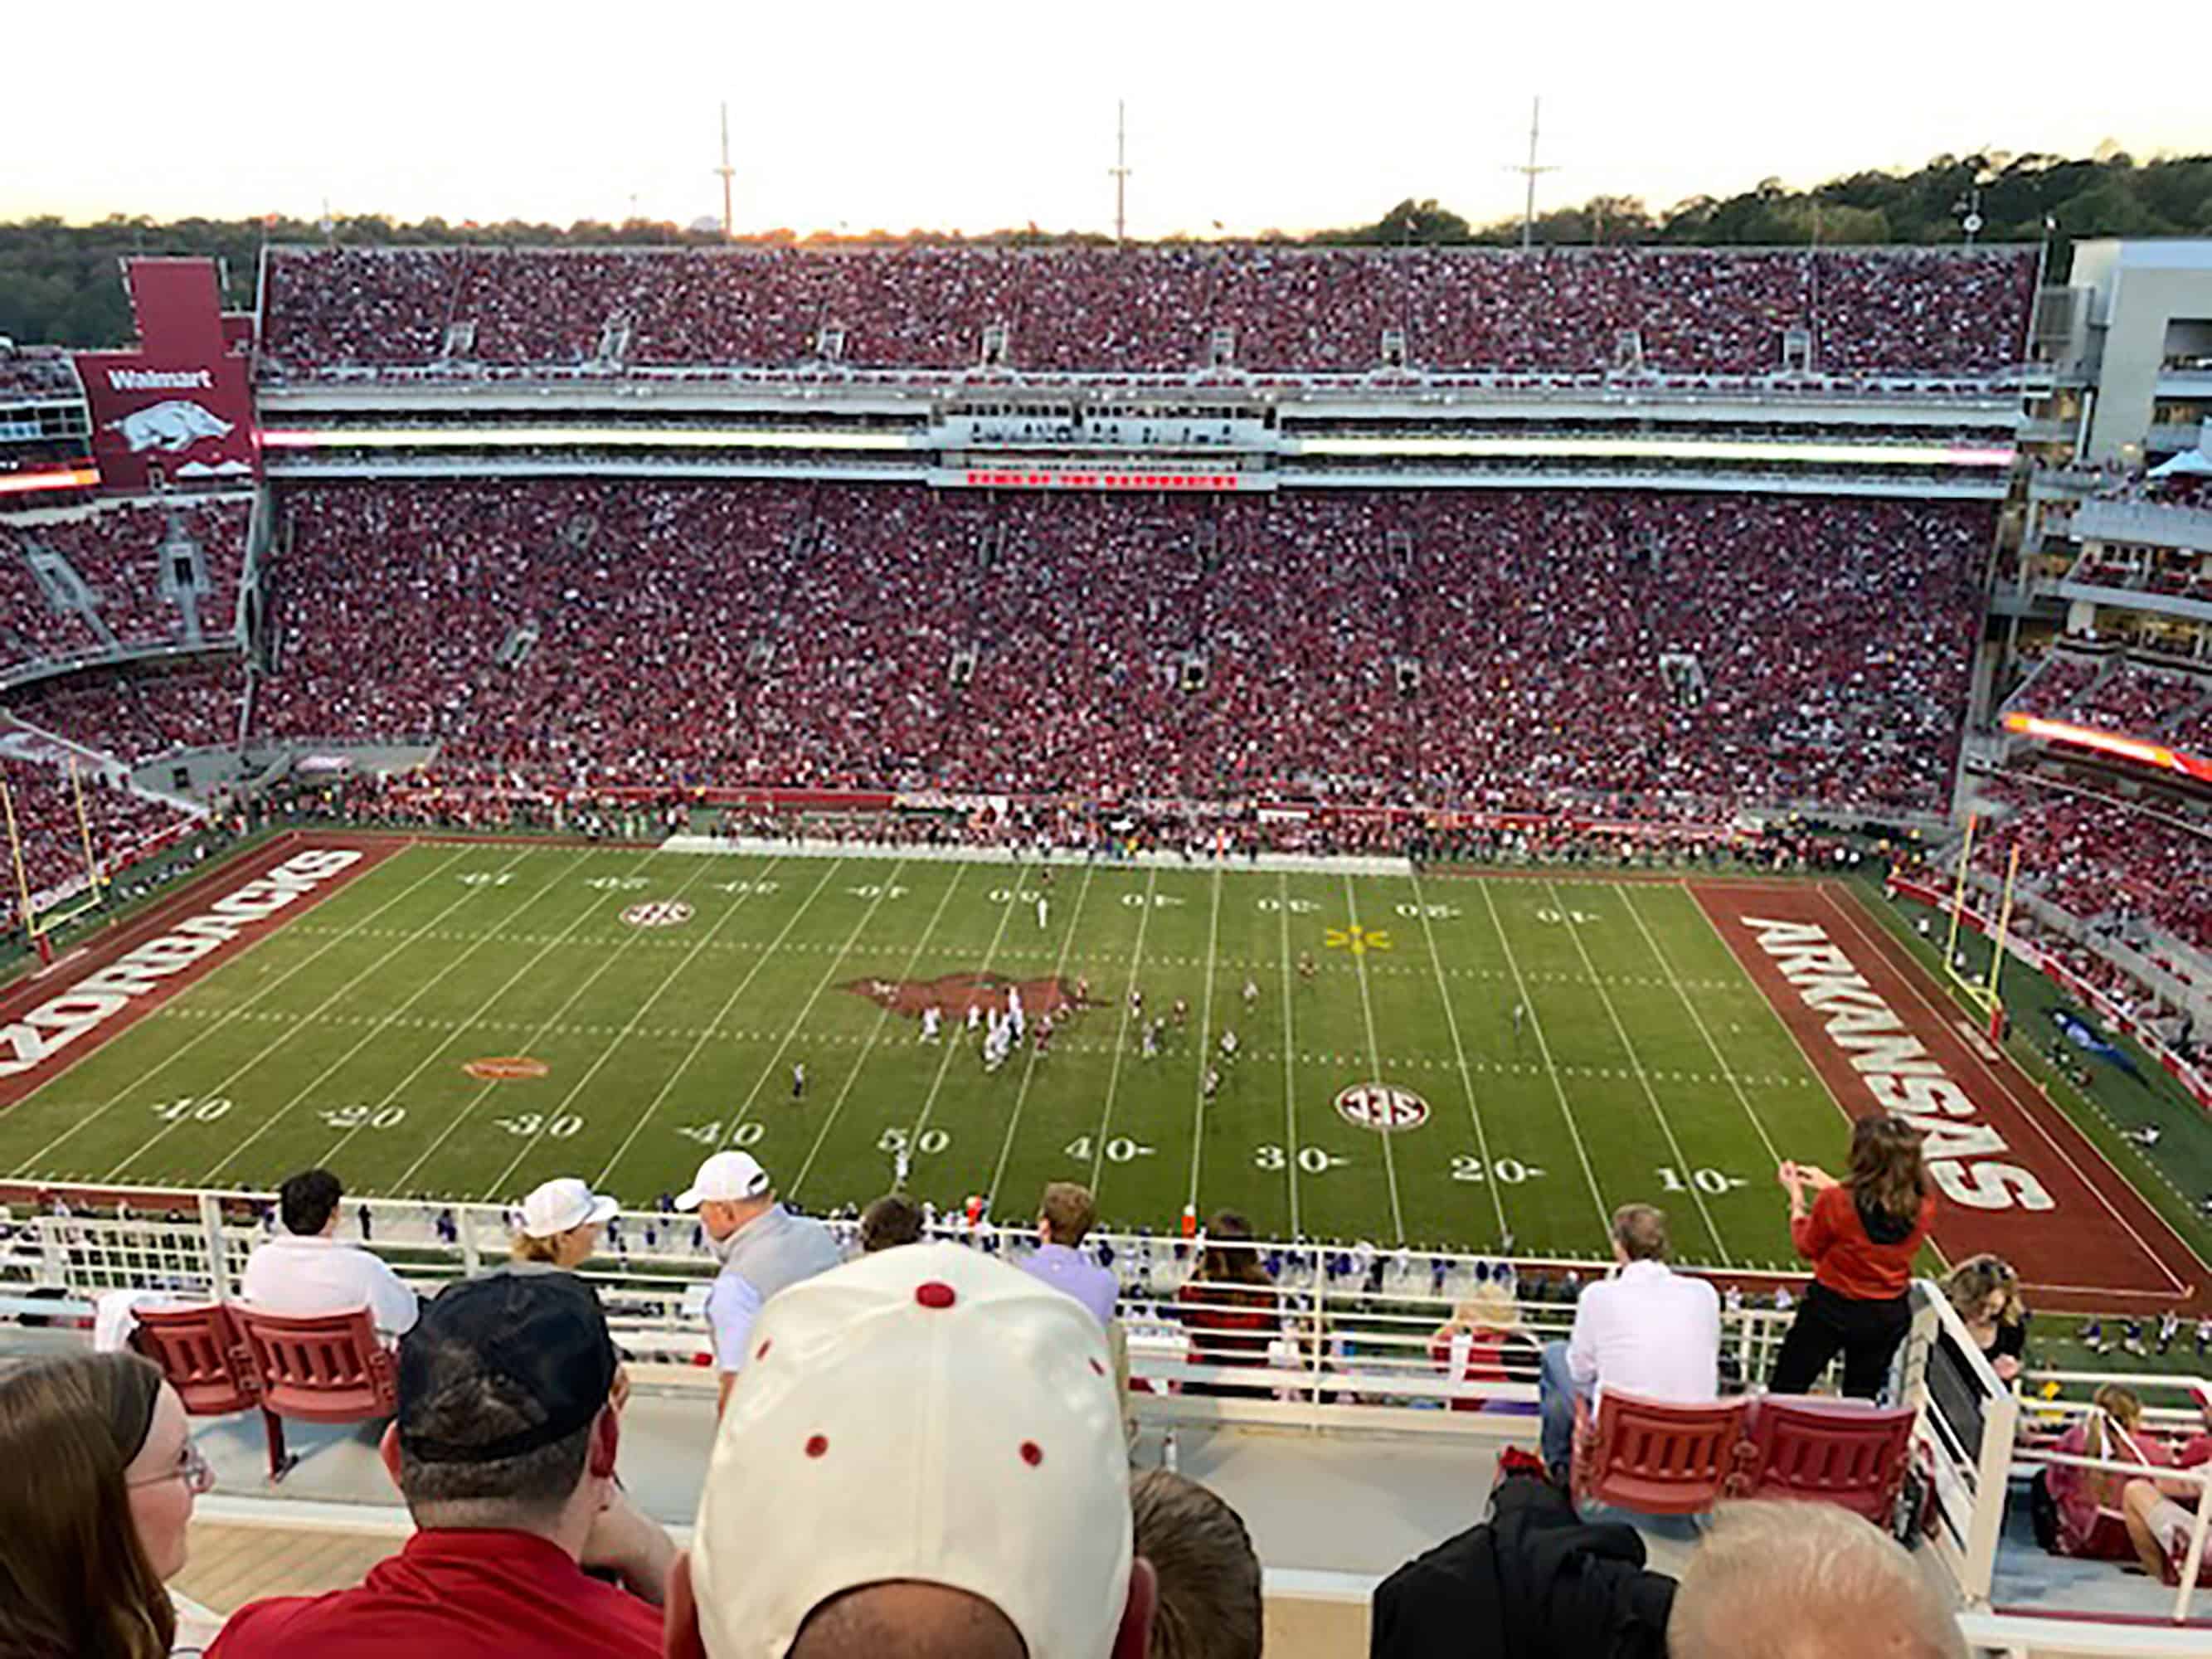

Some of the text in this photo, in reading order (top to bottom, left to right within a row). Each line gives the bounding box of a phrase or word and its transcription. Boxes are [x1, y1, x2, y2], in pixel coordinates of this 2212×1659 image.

[108, 369, 213, 390] Walmart
[0, 849, 363, 1078] ZORBACKS
[1740, 915, 2057, 1212] ARKANSAS
[160, 1097, 232, 1122] 10
[328, 1105, 406, 1128] 20
[507, 1112, 585, 1139] 30
[688, 1120, 766, 1147] 40
[876, 1127, 951, 1155] 50
[1063, 1136, 1137, 1163] 40
[1254, 1145, 1329, 1174] 30
[1451, 1154, 1527, 1185] 20
[1655, 1167, 1729, 1194] 10
